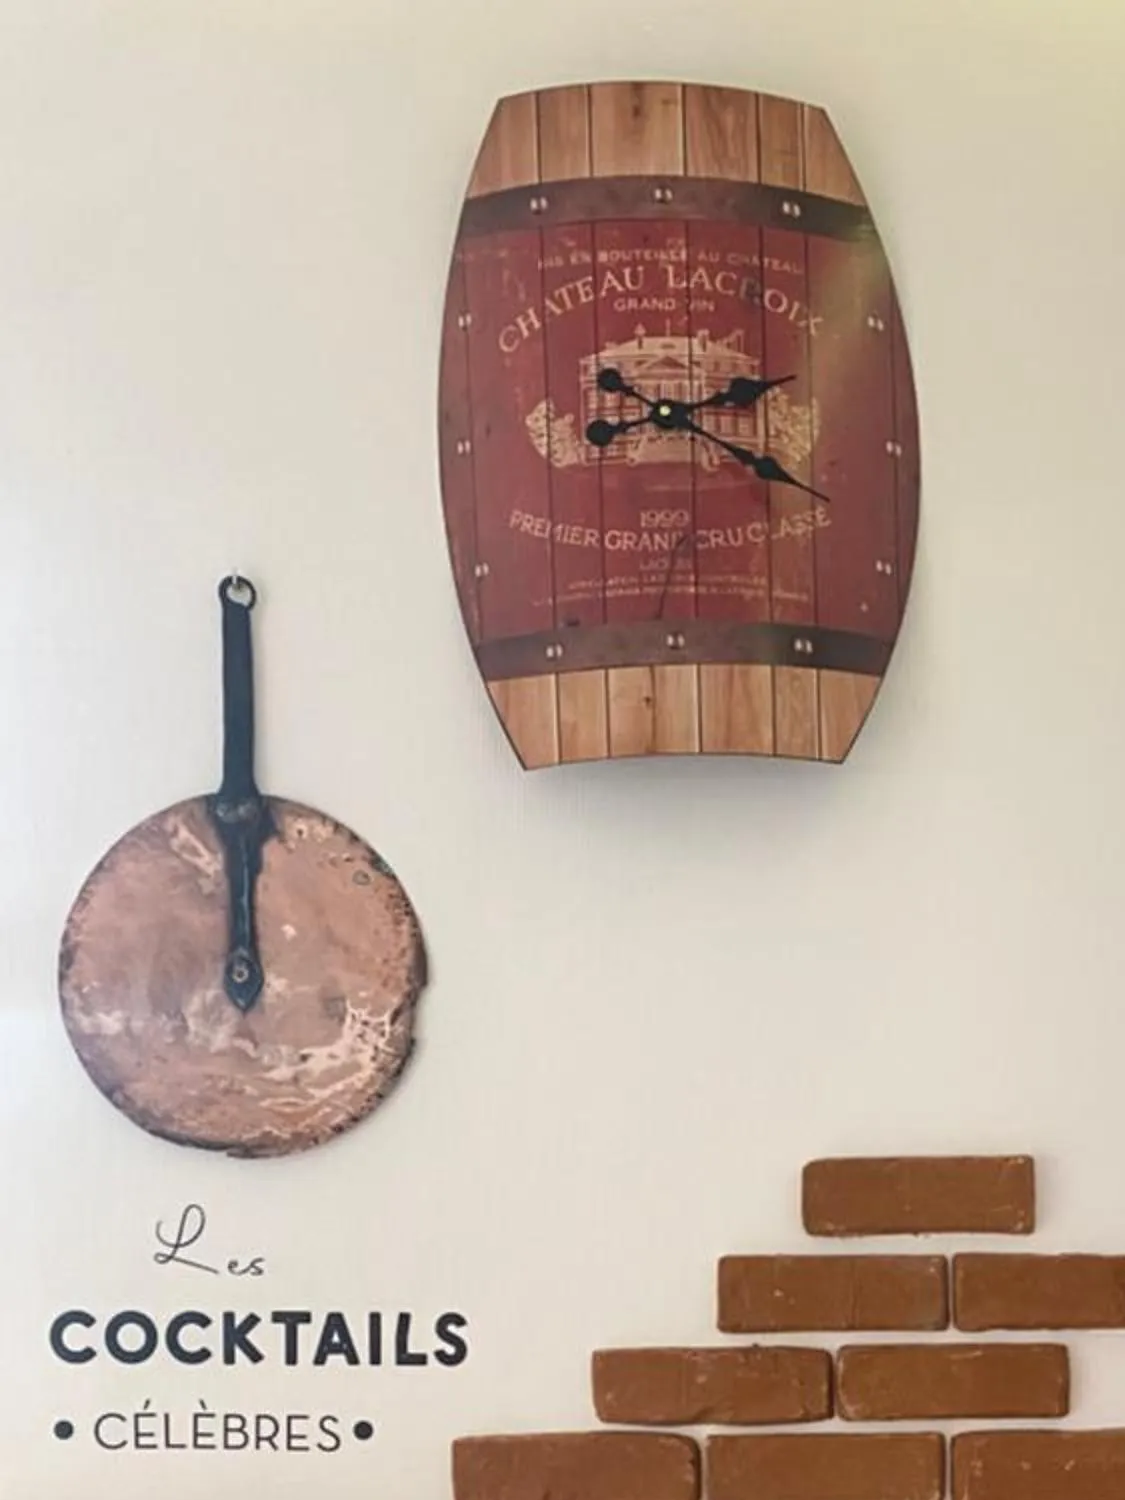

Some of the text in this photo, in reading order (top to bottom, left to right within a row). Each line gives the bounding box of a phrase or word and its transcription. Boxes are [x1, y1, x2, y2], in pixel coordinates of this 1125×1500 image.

[697, 251, 720, 262] AU
[500, 265, 645, 352] CHATEAU
[613, 297, 676, 312] GRAND
[509, 509, 600, 547] PREMIER
[696, 526, 743, 550] CRU
[153, 1203, 266, 1277] Les
[49, 1310, 469, 1368] COCKTAILS
[93, 1398, 342, 1453] CÉLÈBRES
